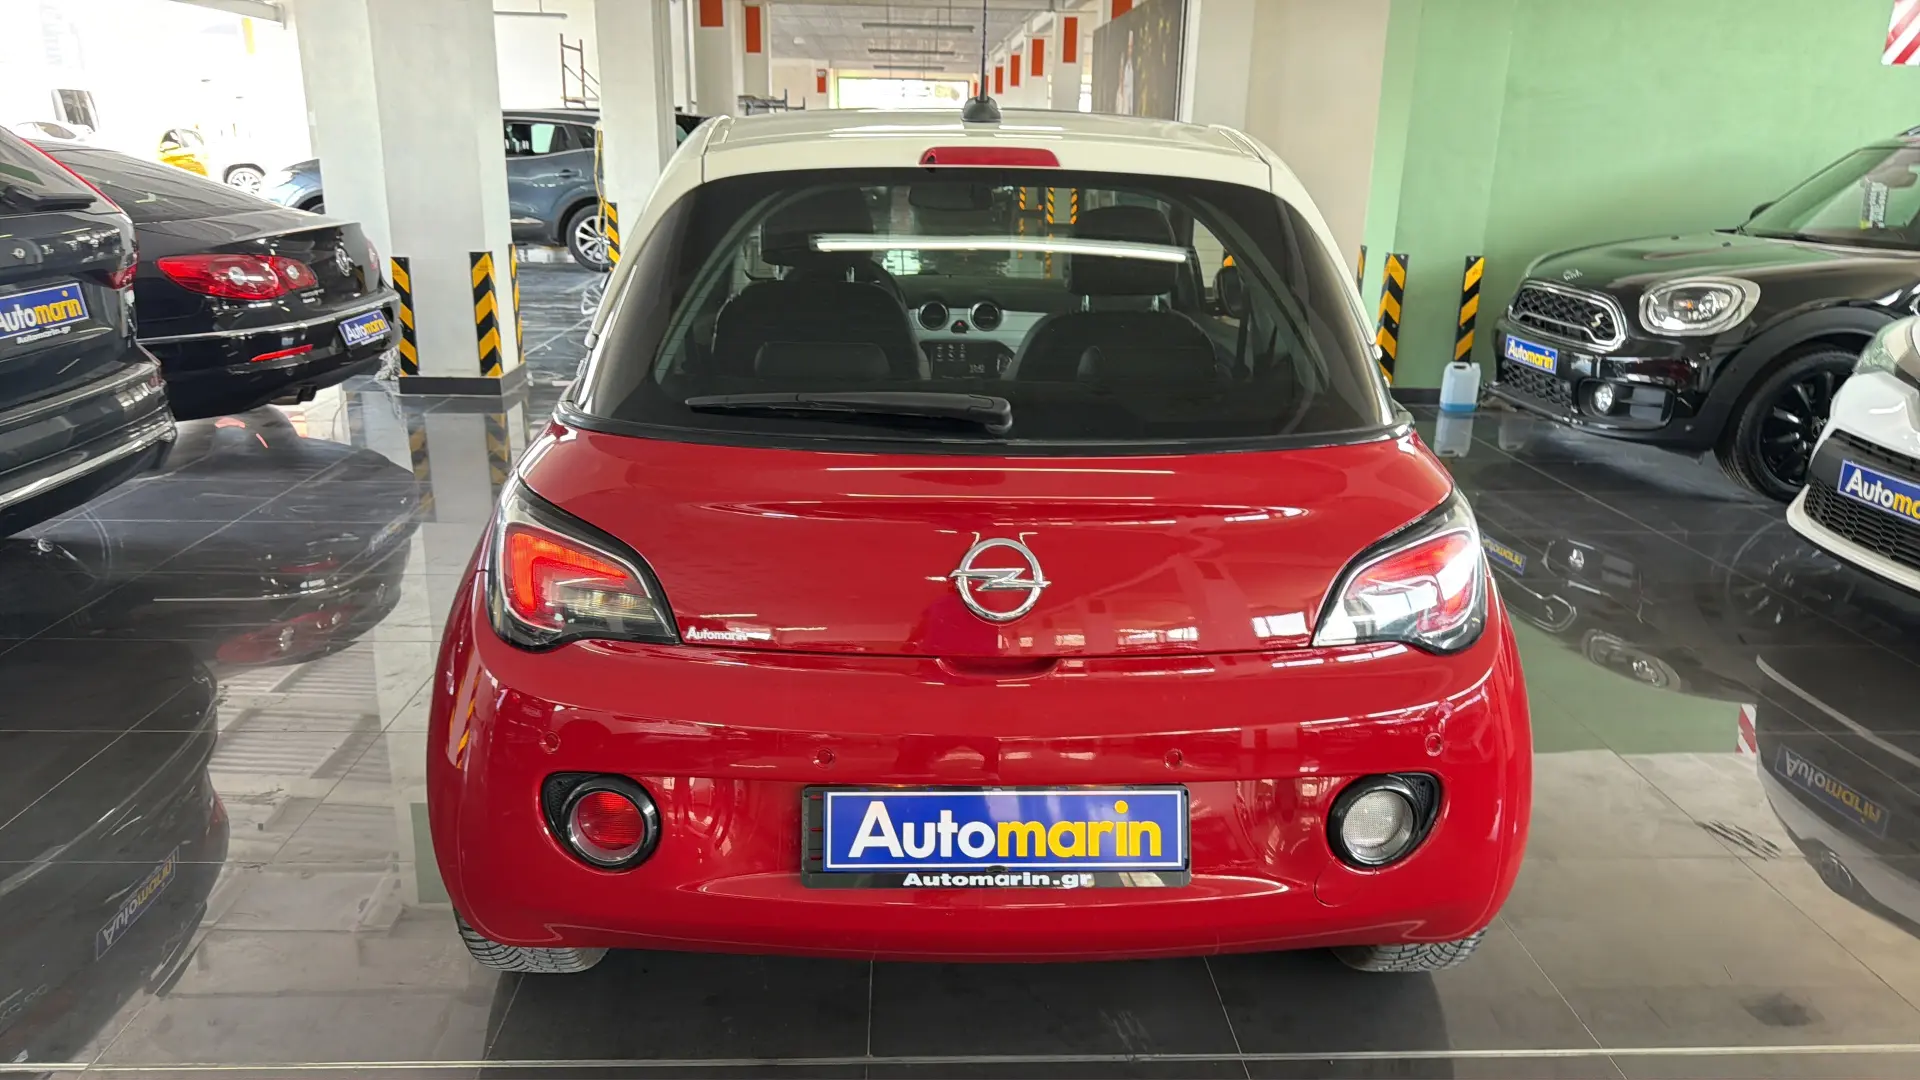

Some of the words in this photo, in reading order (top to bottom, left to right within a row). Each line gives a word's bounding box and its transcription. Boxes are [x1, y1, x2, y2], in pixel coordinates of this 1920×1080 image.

[1508, 339, 1555, 369] Automarin
[848, 800, 1162, 858] Automarin
[902, 872, 1092, 889] Automarin.gr
